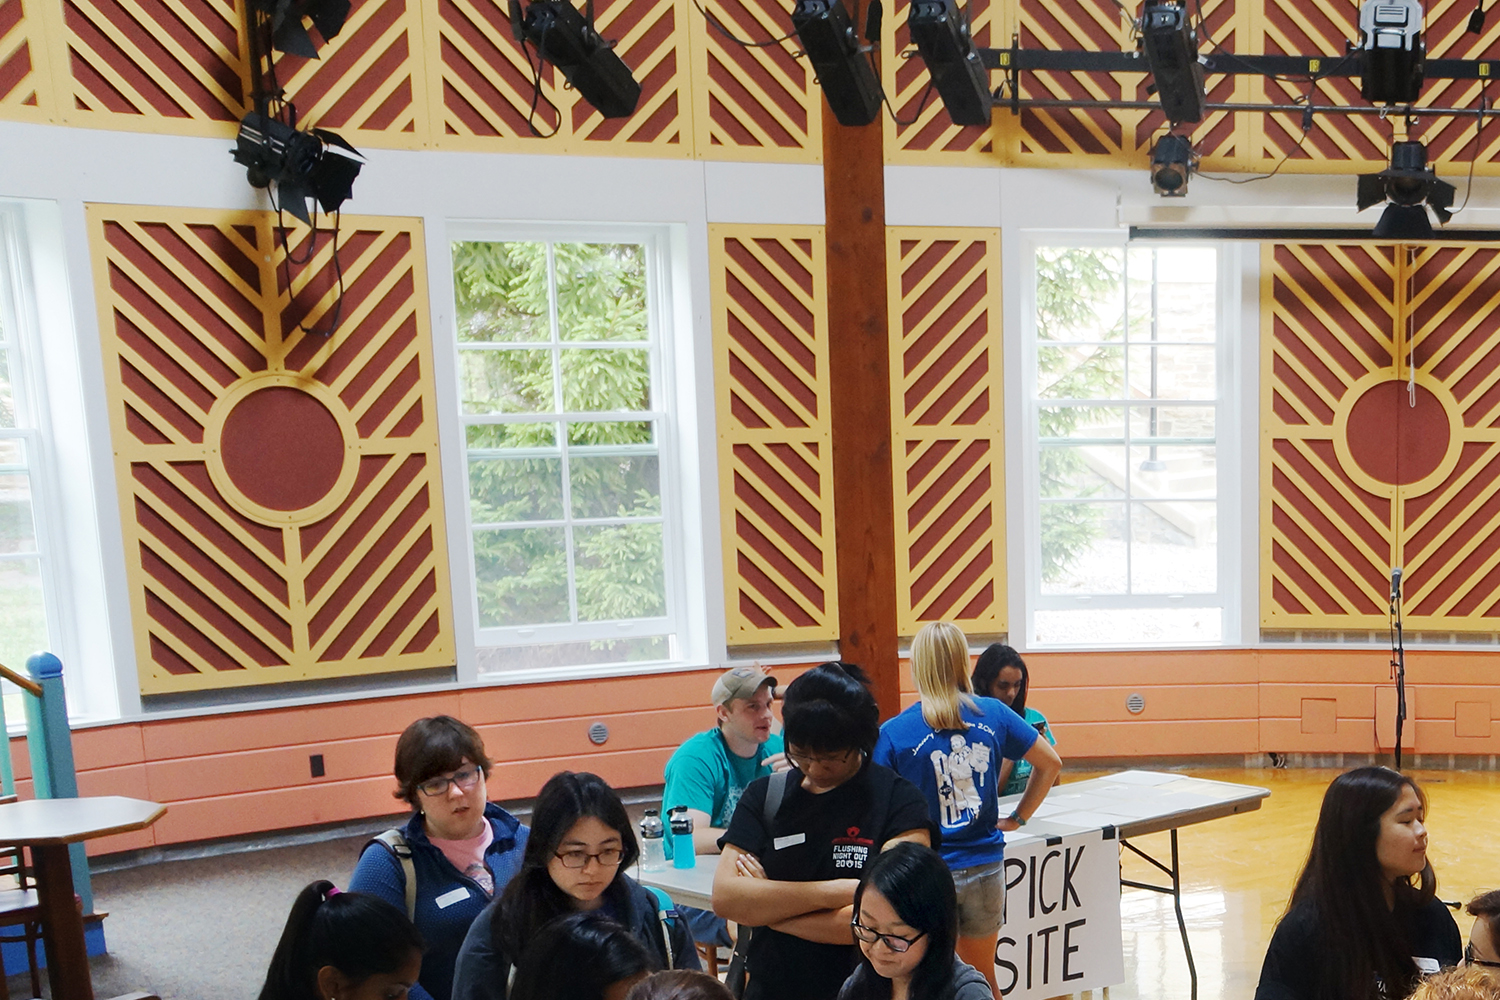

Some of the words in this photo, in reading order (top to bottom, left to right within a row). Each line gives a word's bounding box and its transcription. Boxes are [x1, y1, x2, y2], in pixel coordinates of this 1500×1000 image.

[833, 845, 868, 854] FLUSHING
[853, 853, 867, 861] OUT
[1003, 845, 1086, 924] PICK
[994, 918, 1086, 996] SITE
